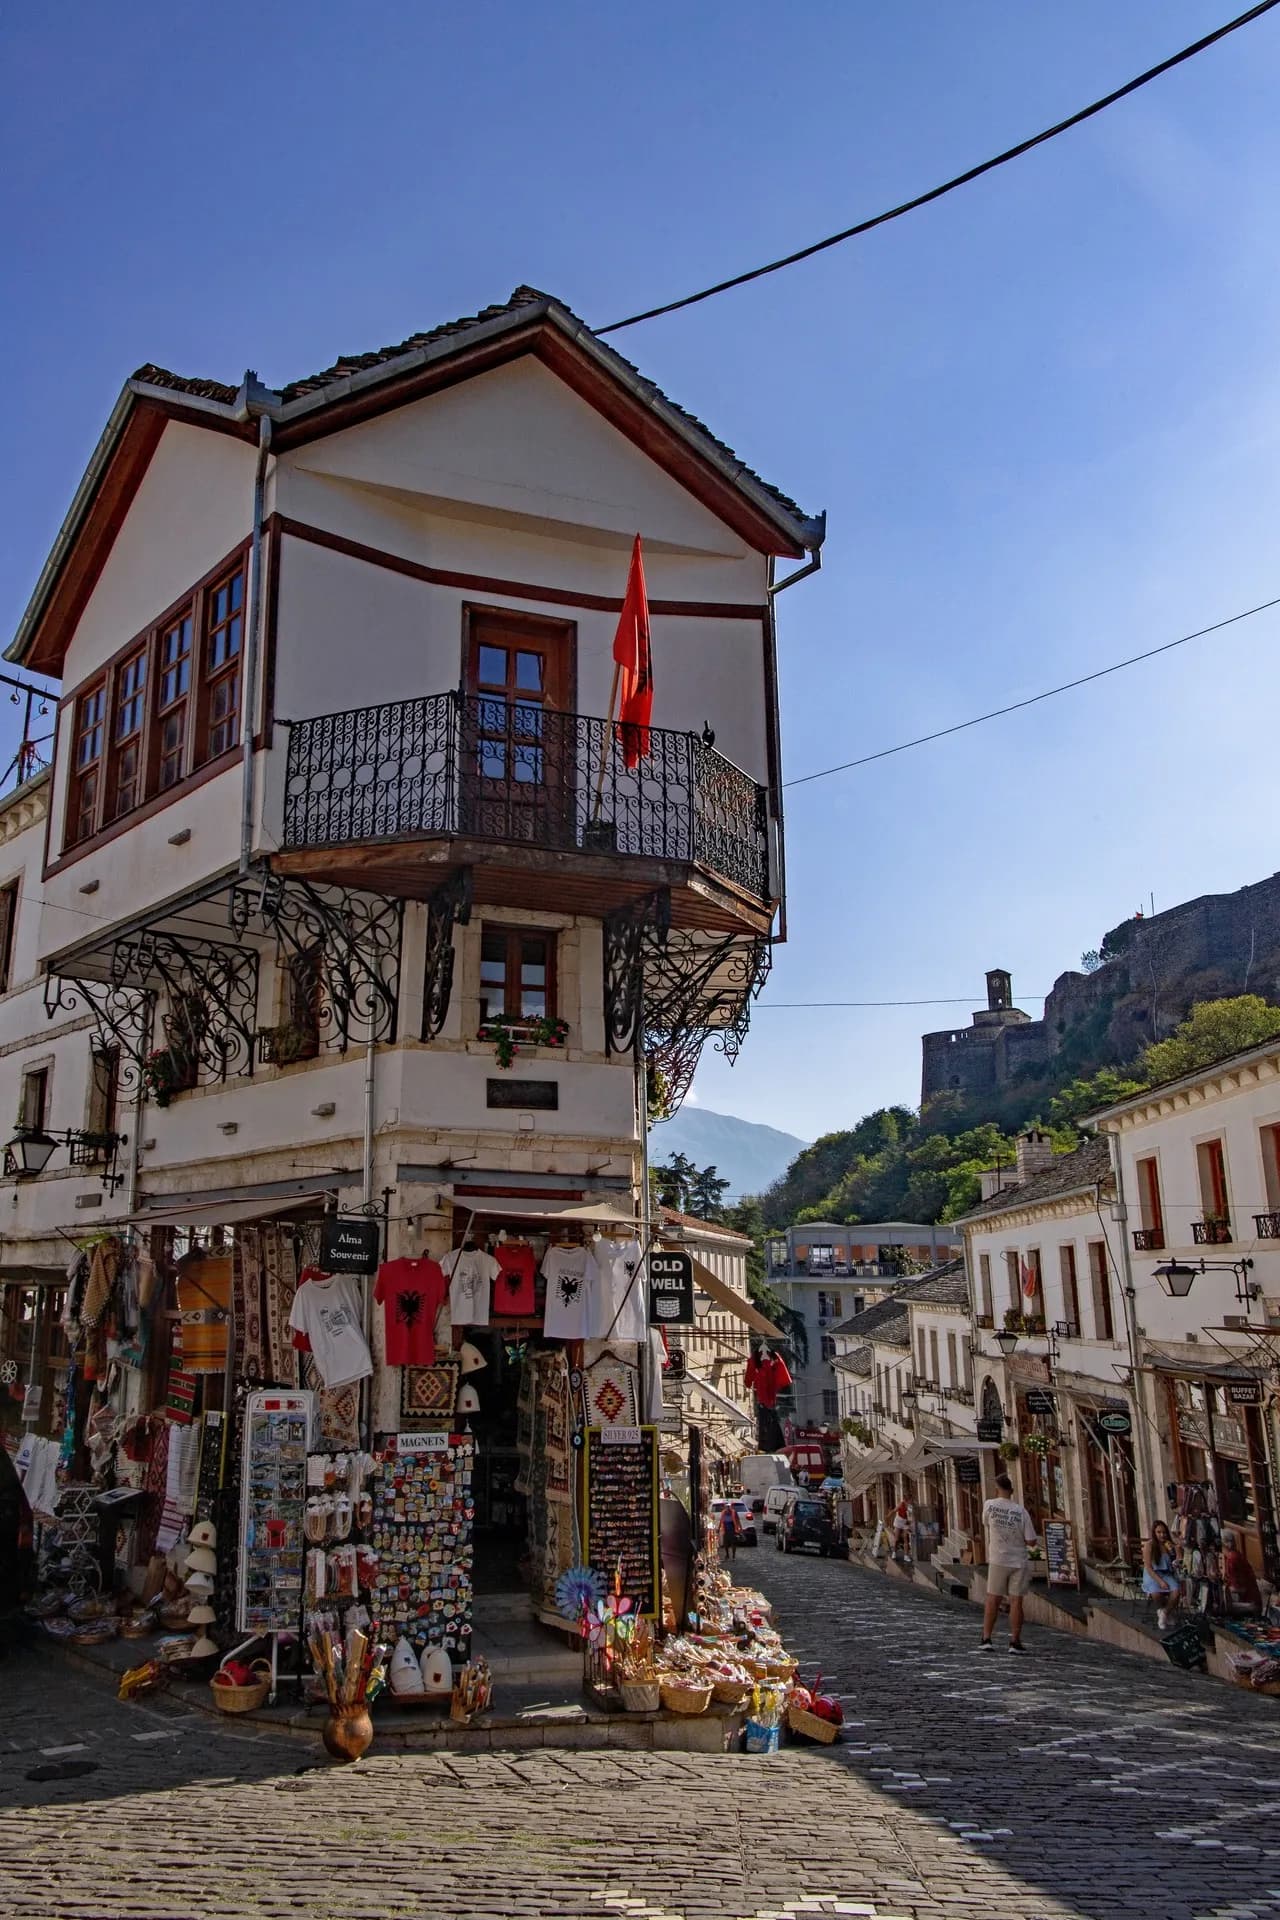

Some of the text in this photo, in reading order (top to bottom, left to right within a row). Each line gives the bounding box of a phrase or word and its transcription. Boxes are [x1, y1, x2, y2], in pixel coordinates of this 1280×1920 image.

[338, 1233, 362, 1245] Alma
[330, 1248, 370, 1261] Souvenir
[651, 1260, 684, 1272] OLD
[651, 1278, 686, 1290] WELL
[603, 1430, 639, 1441] SILVER 925
[400, 1436, 445, 1448] MAGNETS
